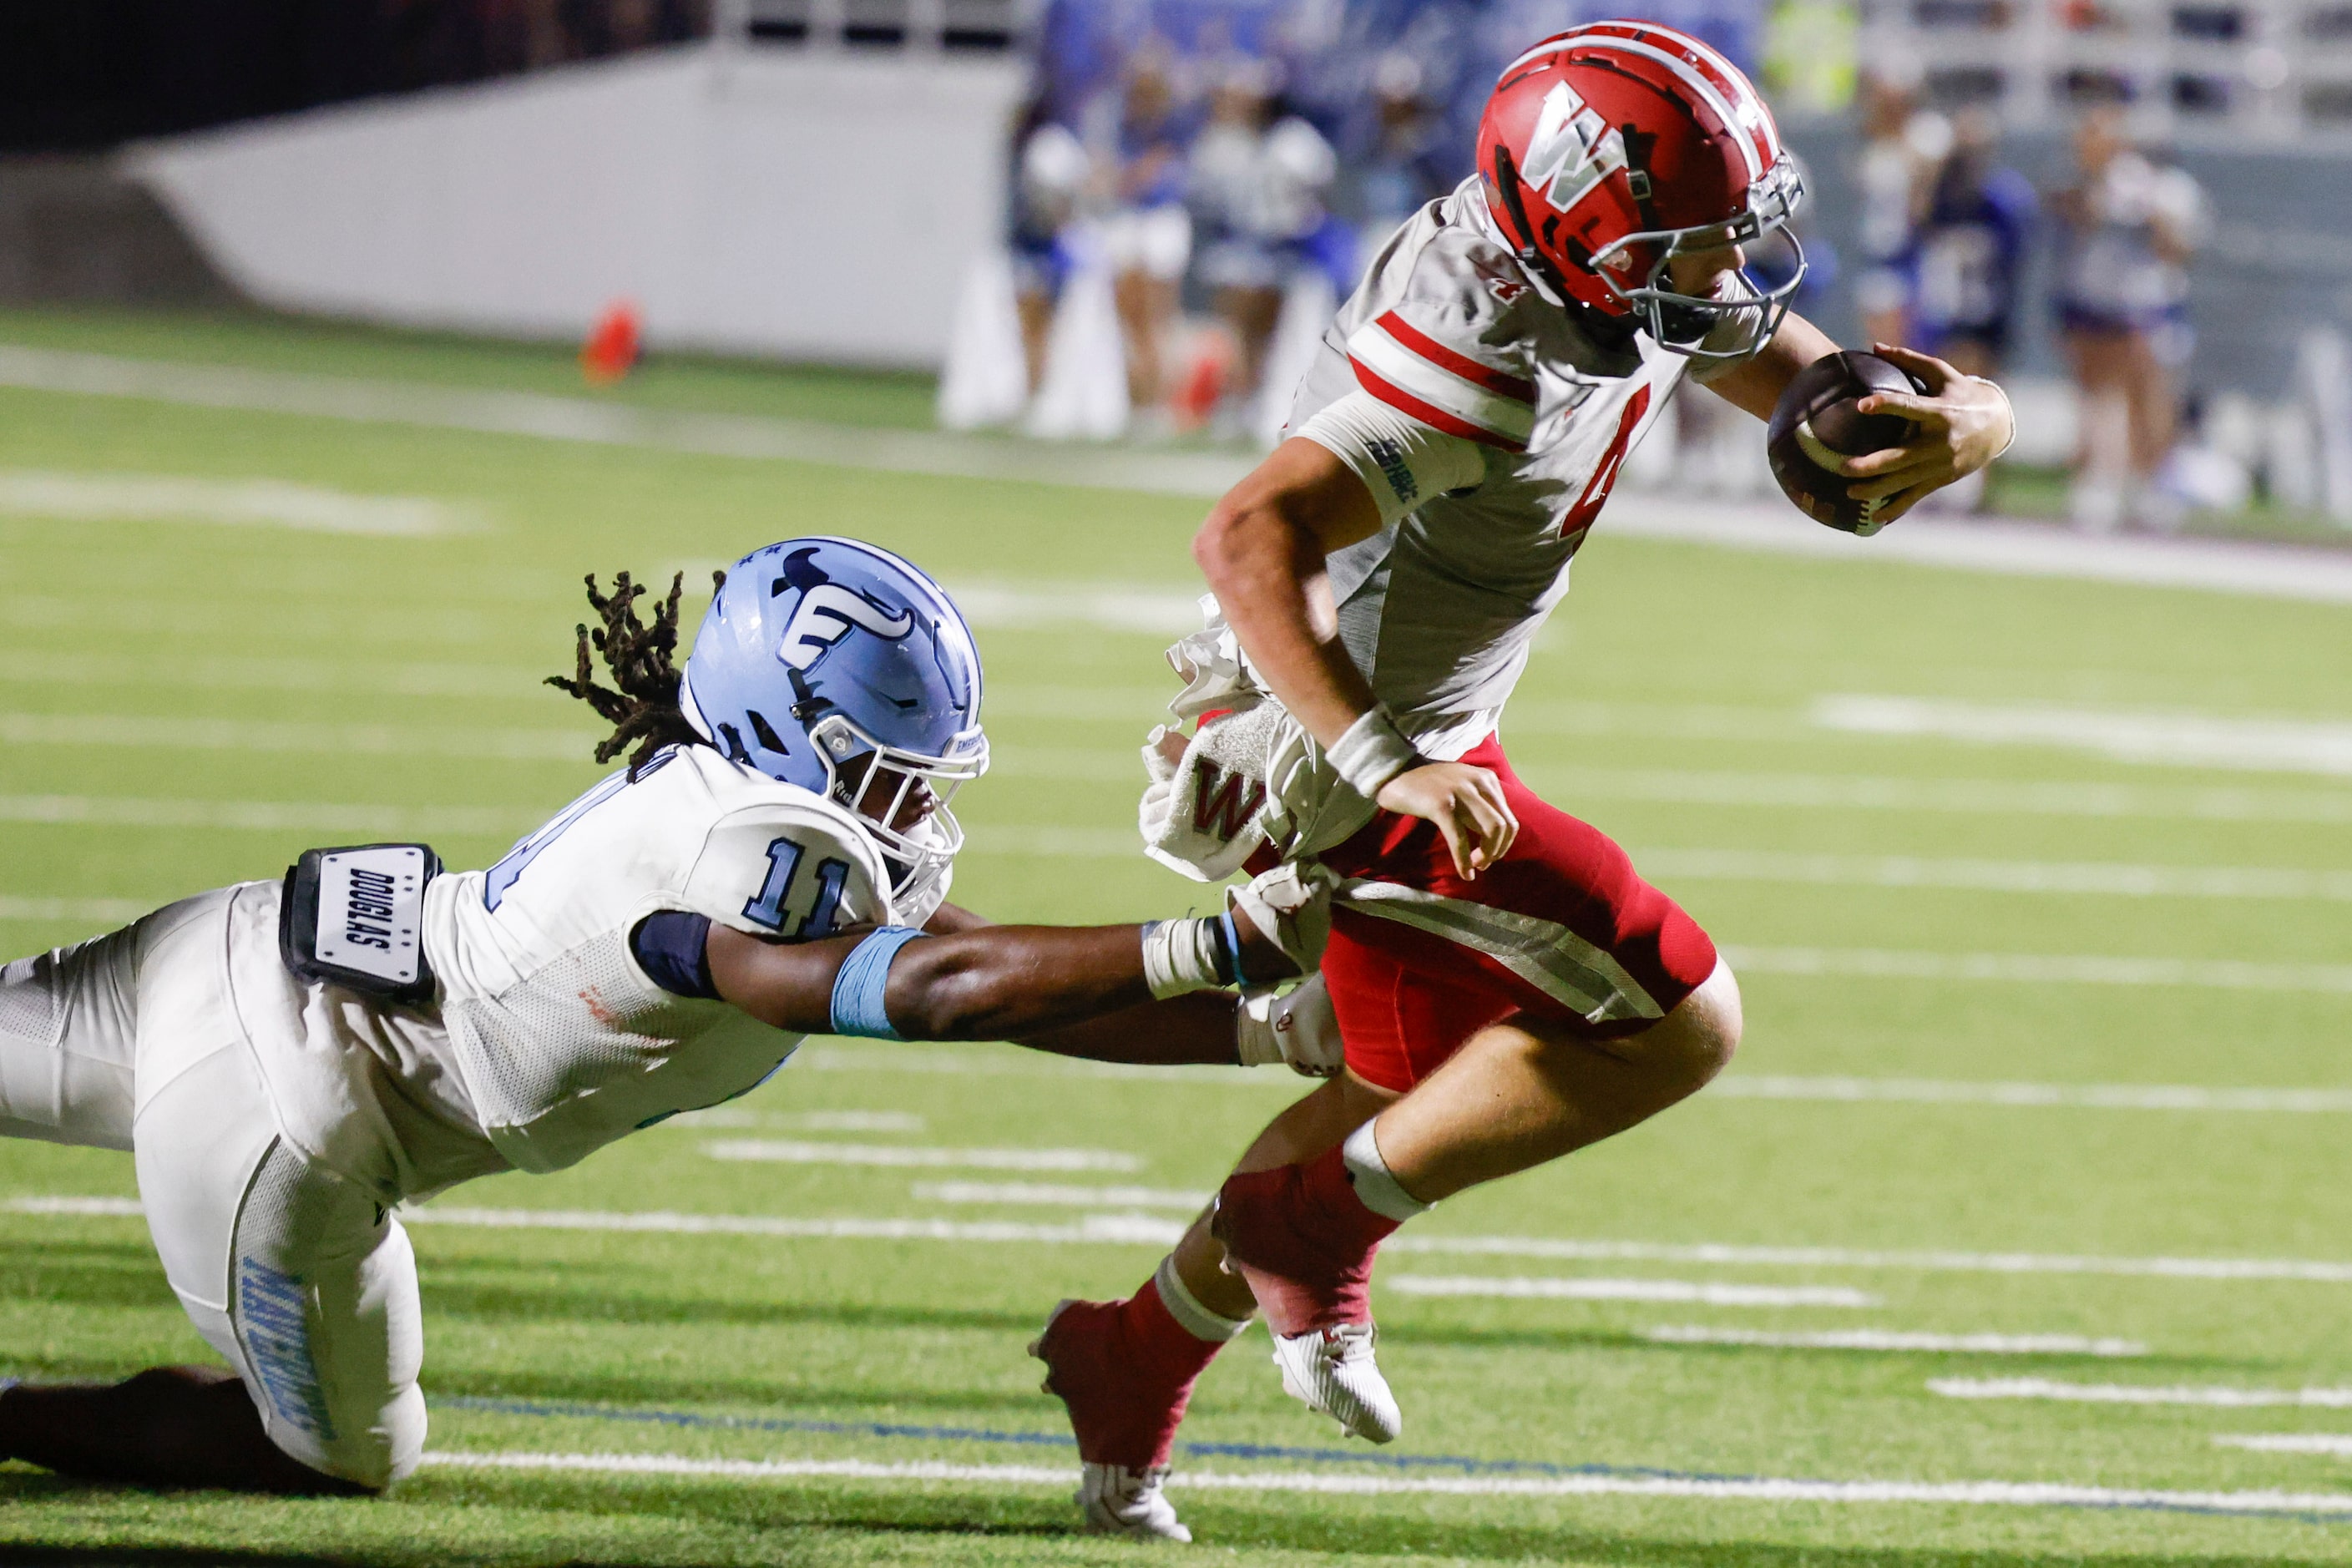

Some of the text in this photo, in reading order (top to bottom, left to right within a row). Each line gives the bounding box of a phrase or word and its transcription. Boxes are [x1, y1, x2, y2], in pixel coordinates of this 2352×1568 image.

[1521, 79, 1629, 215] W
[1193, 754, 1267, 842] W
[346, 868, 395, 949] DOUGLAS
[741, 837, 850, 938] 11
